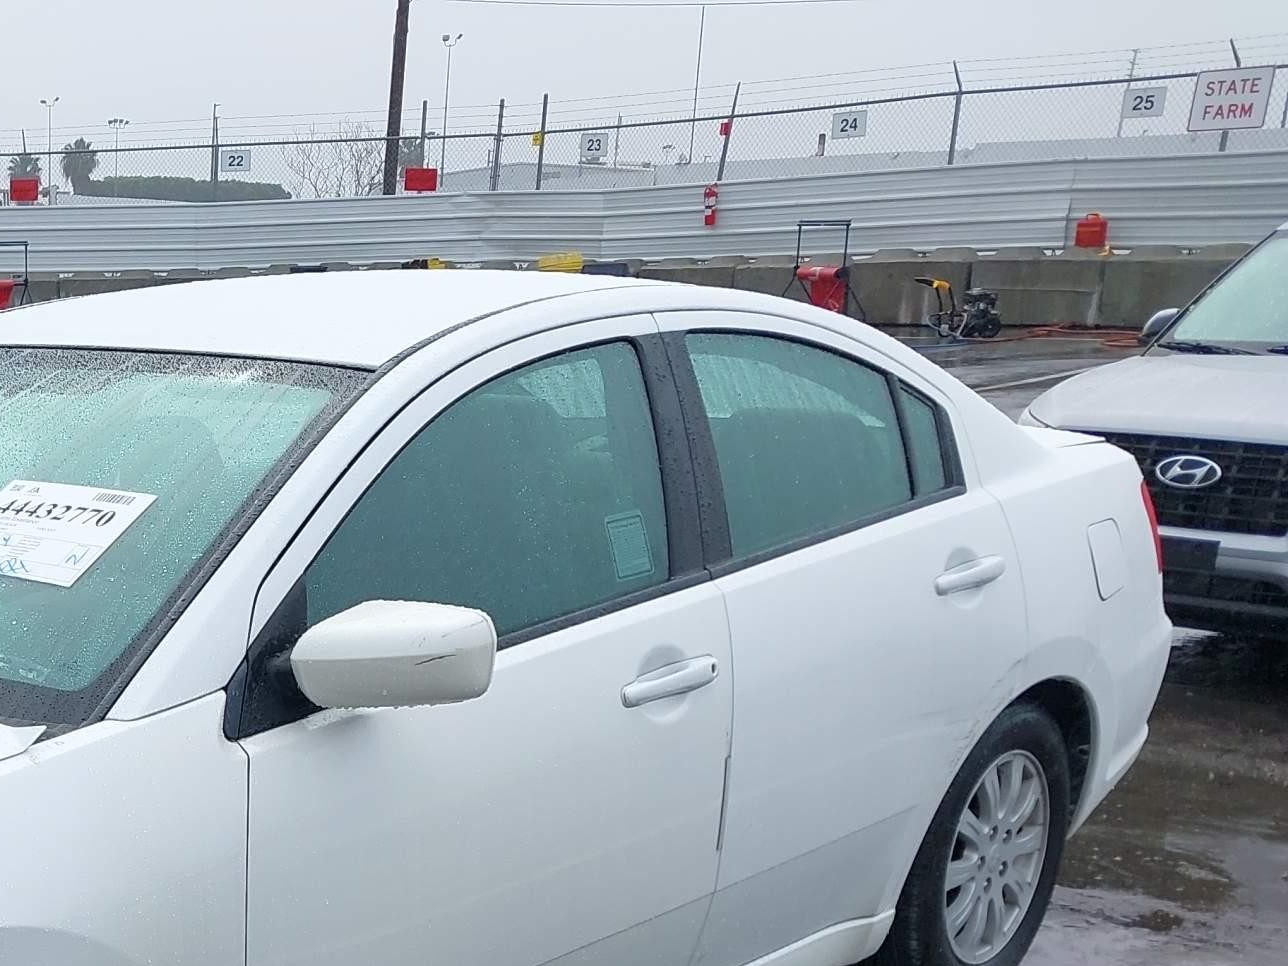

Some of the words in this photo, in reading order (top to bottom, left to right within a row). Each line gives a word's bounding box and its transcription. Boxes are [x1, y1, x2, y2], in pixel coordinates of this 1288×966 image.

[1204, 77, 1262, 97] STATE
[1132, 95, 1155, 111] 25
[1202, 102, 1254, 120] FARM
[840, 117, 858, 133] 24
[587, 138, 602, 152] 23
[228, 155, 244, 167] 22
